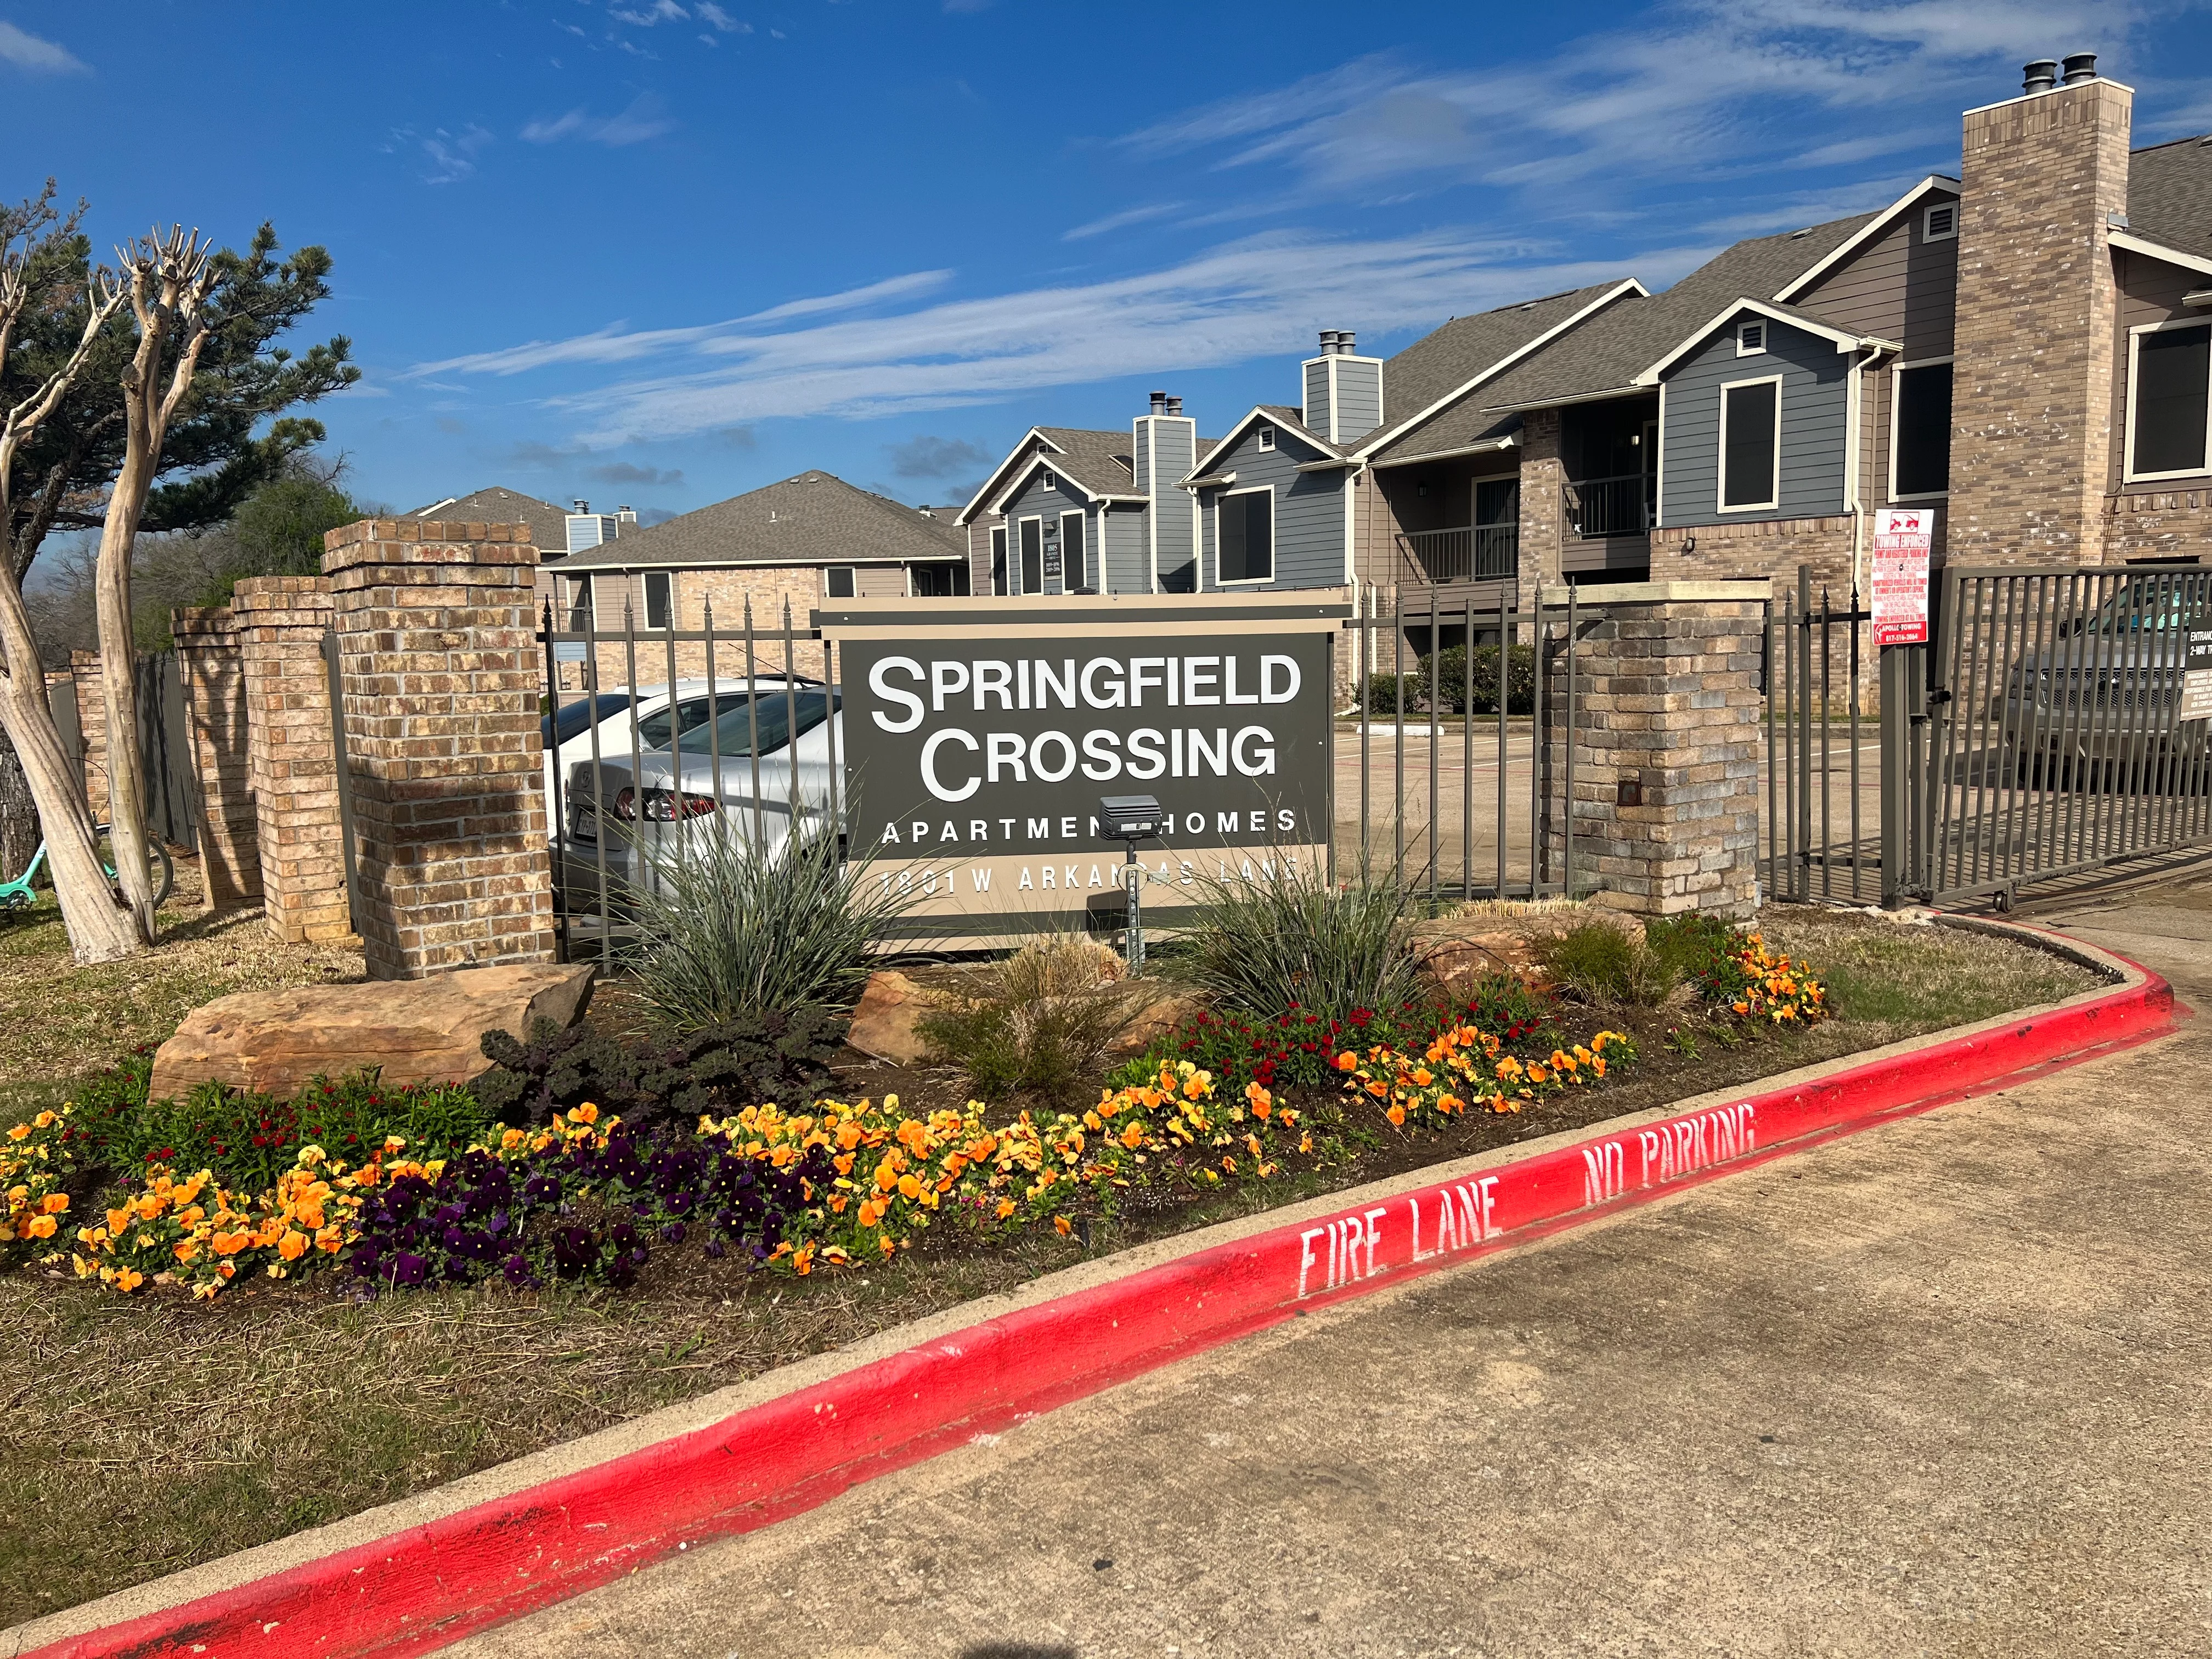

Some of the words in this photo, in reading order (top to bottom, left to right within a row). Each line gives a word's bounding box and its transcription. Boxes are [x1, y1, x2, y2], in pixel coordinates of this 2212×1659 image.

[1876, 534, 1900, 548] TOWING
[1900, 534, 1929, 548] ENFORCED
[1900, 623, 1921, 631] TOWING
[869, 654, 1301, 733] SPRINGFIELD
[921, 725, 1276, 802] CROSSING
[1158, 809, 1295, 834] HOMES
[879, 869, 955, 896] 1801
[971, 868, 992, 893] W
[1220, 857, 1297, 883] LANE
[1298, 1207, 1387, 1299] FIRE
[1408, 1176, 1503, 1262] LANE
[1582, 1141, 1624, 1206] NO
[1638, 1103, 1755, 1189] PARKING
